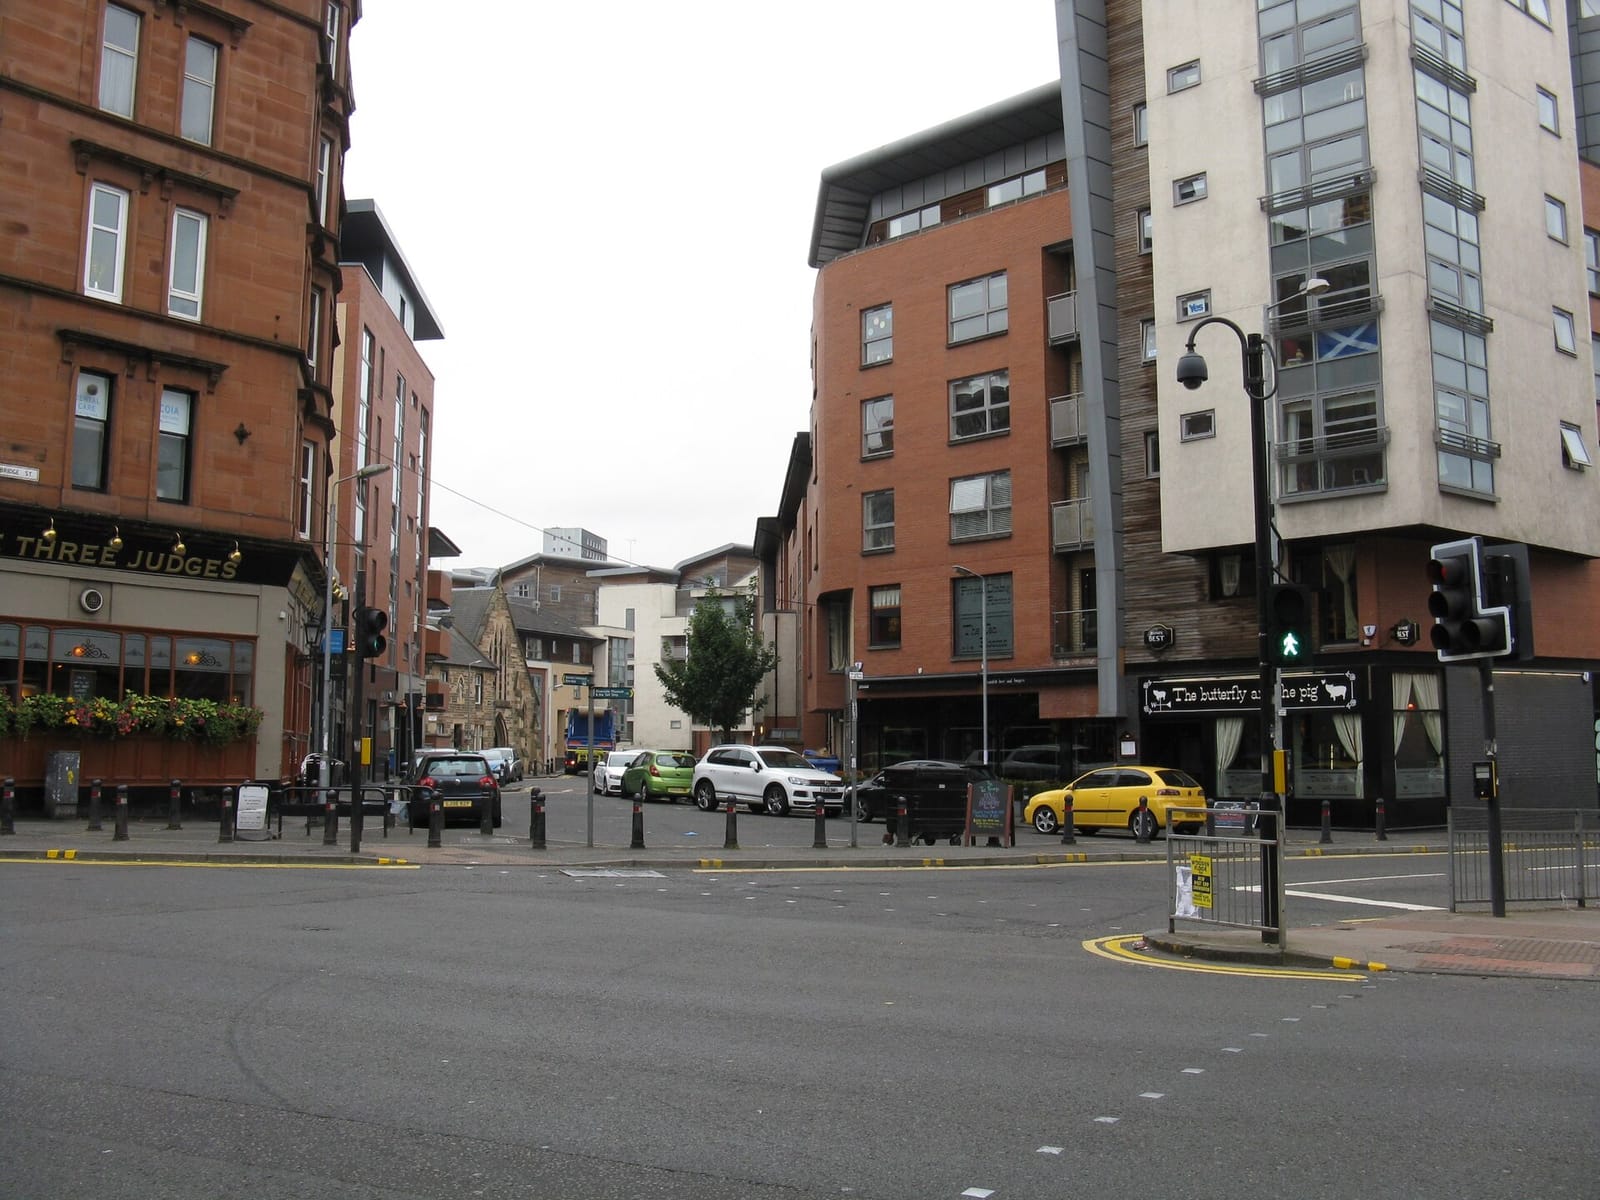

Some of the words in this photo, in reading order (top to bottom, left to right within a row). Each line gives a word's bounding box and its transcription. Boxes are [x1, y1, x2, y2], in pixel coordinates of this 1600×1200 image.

[1189, 303, 1204, 313] Yes
[16, 535, 119, 567] THREE
[127, 550, 240, 580] JUDGES
[1172, 686, 1198, 702] The
[1199, 684, 1248, 704] butterfly
[1281, 683, 1296, 699] he
[1299, 682, 1319, 702] pig
